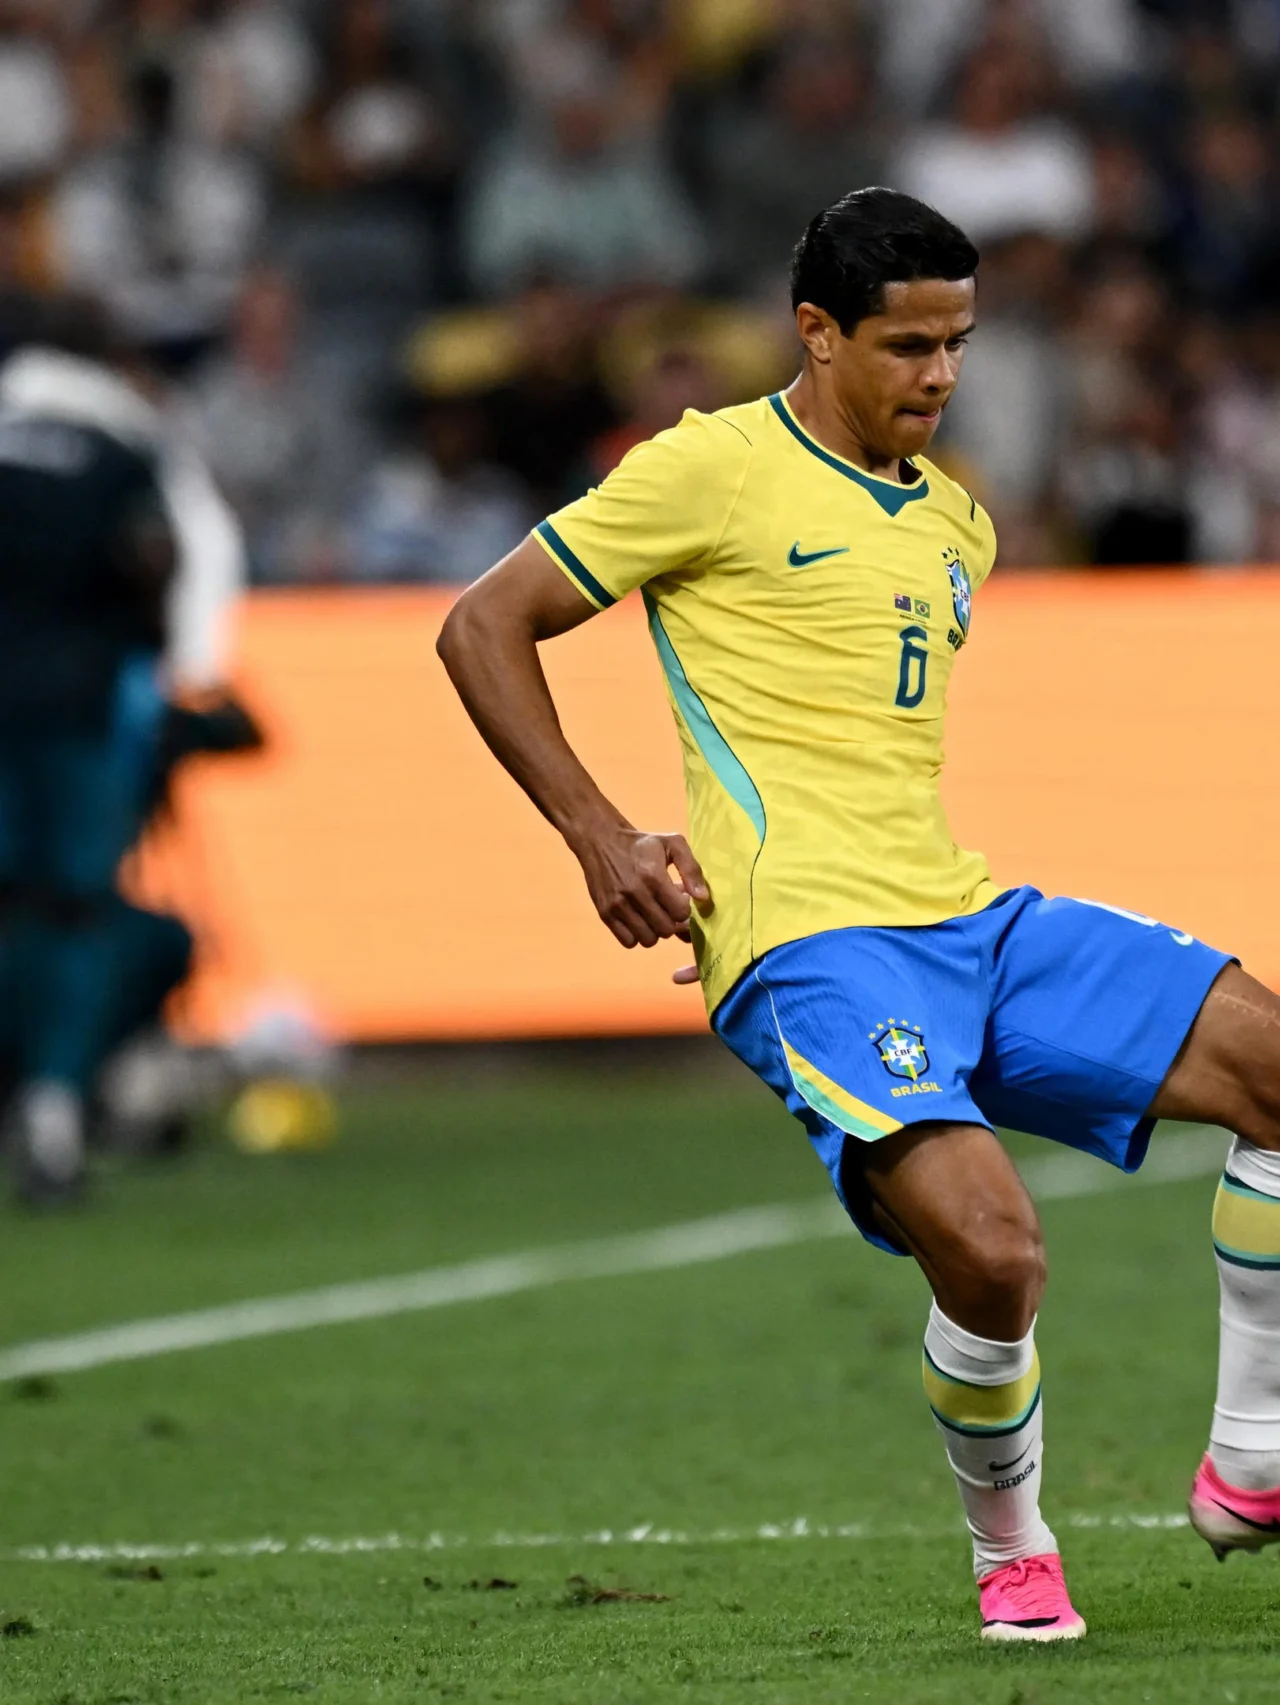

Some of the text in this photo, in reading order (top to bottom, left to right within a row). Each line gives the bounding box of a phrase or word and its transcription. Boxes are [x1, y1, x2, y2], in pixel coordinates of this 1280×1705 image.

[895, 624, 929, 710] 6
[894, 1048, 913, 1058] CBF
[891, 1081, 943, 1097] BRASIL
[994, 1460, 1037, 1491] BRASIL
